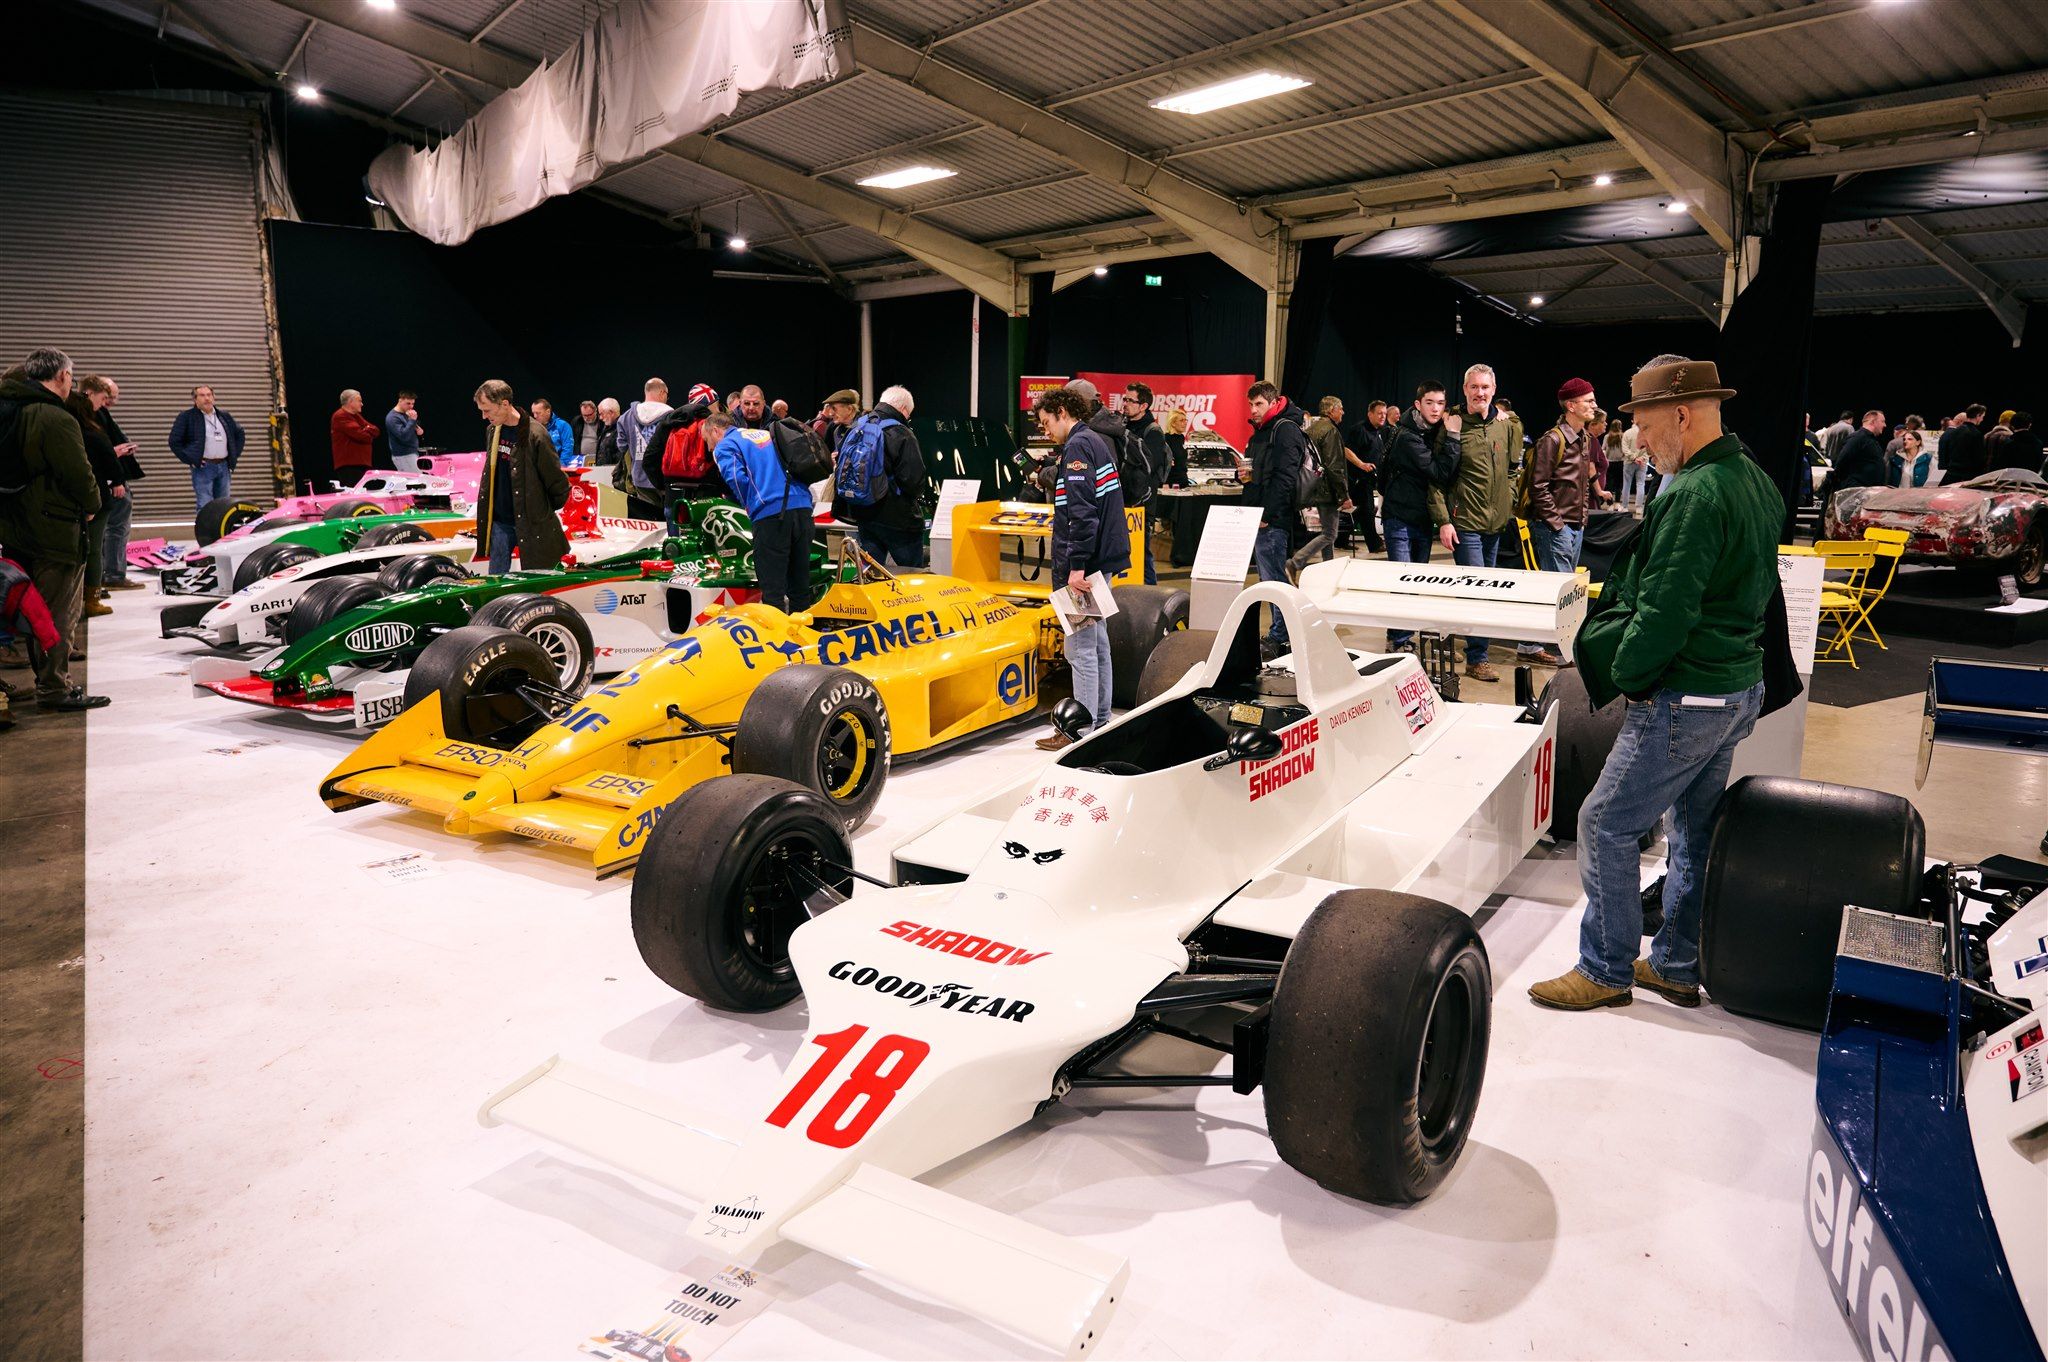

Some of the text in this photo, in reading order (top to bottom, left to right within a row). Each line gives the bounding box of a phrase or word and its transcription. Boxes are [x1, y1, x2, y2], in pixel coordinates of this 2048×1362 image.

[1109, 393, 1217, 411] MORSPORT
[602, 517, 658, 532] HONDA
[126, 546, 151, 554] cronis
[620, 594, 647, 606] AT&T
[829, 603, 868, 616] Nakajima
[881, 593, 925, 608] COURTAULDS
[707, 614, 765, 670] MEL
[818, 610, 956, 666] CAMEL
[463, 642, 507, 687] EAGLE
[363, 696, 404, 724] HSB
[1329, 699, 1374, 729] DAVID KENNEDY
[1240, 718, 1319, 776] DORE
[586, 774, 655, 796] EPS
[1249, 748, 1316, 802] SHADOW
[1533, 737, 1552, 831] 18
[1034, 807, 1075, 827] 香港
[880, 920, 1053, 966] SHADOW
[764, 1024, 931, 1149] 18
[711, 1204, 765, 1221] SHADOW
[1809, 1149, 1875, 1314] elf
[682, 1283, 742, 1309] DO NOT
[664, 1299, 720, 1326] TOUCH
[1868, 1265, 1956, 1362] el
